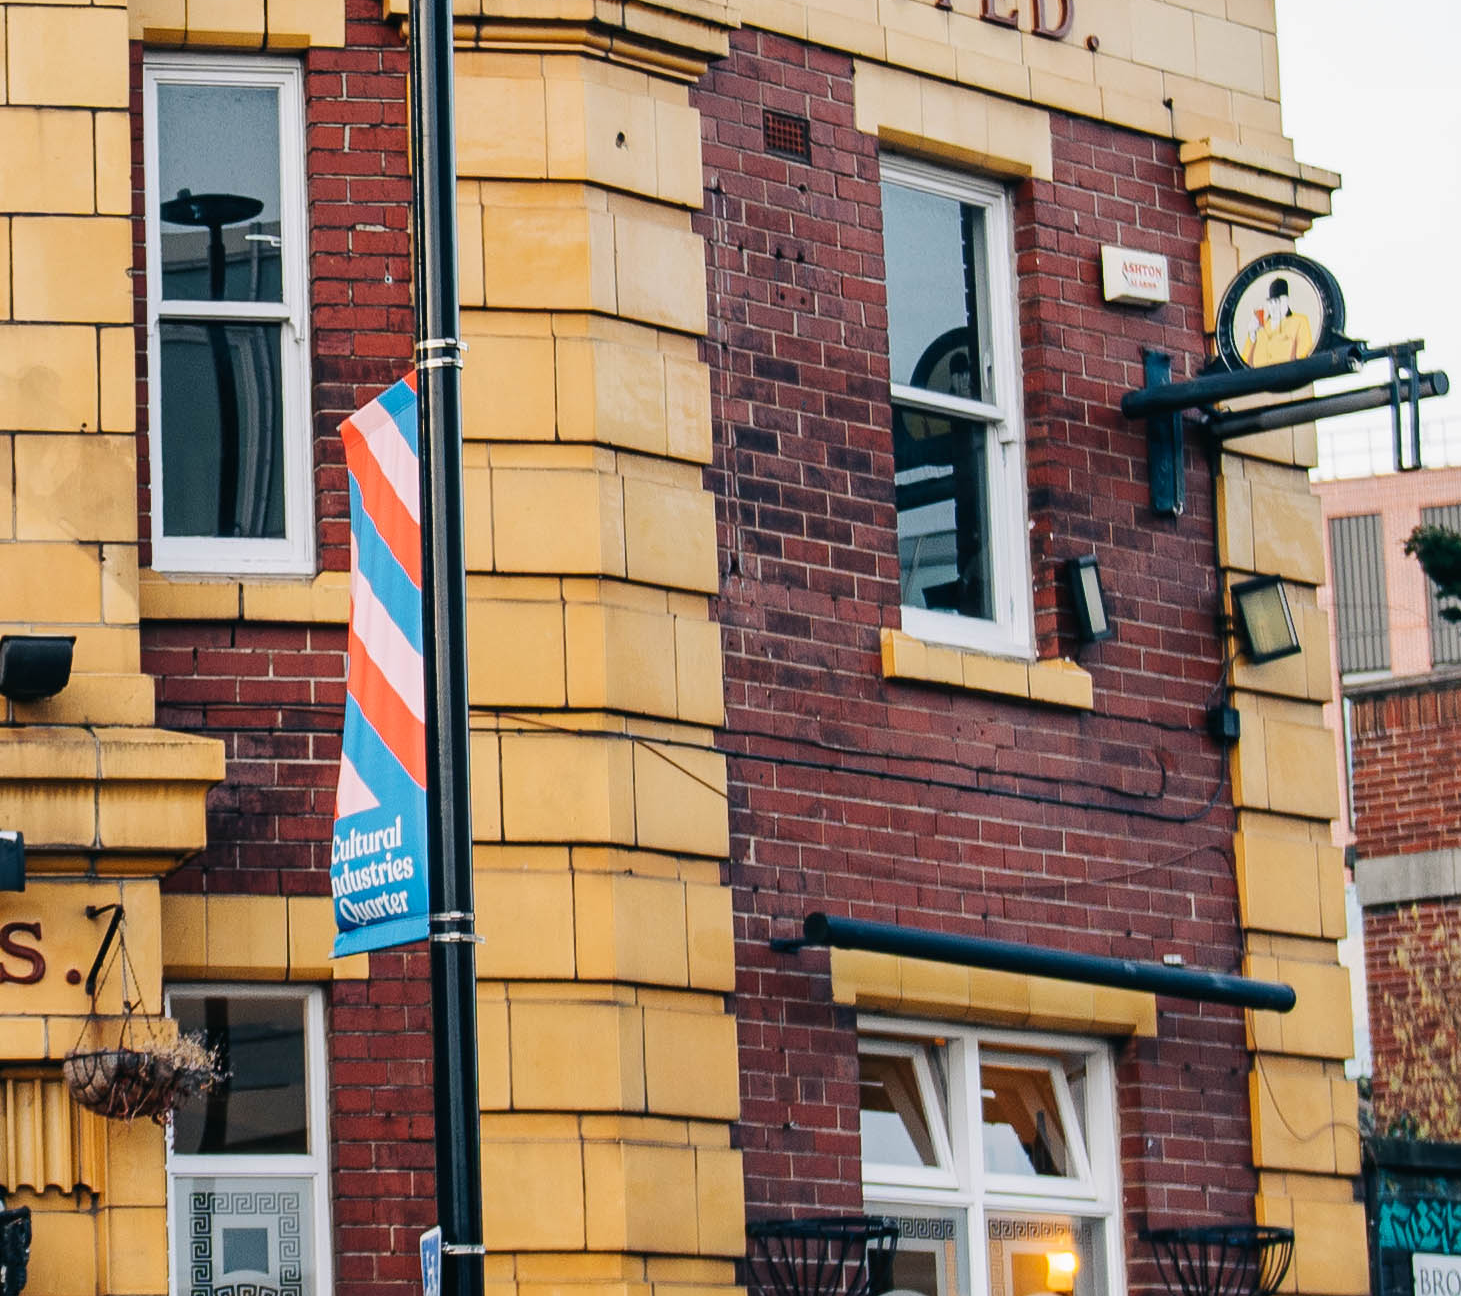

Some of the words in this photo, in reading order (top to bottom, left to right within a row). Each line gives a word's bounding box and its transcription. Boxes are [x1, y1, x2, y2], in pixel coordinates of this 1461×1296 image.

[1121, 261, 1162, 278] ASHTON
[331, 815, 403, 865] Cultural
[331, 854, 414, 899] ndustries
[339, 890, 409, 925] Quarter
